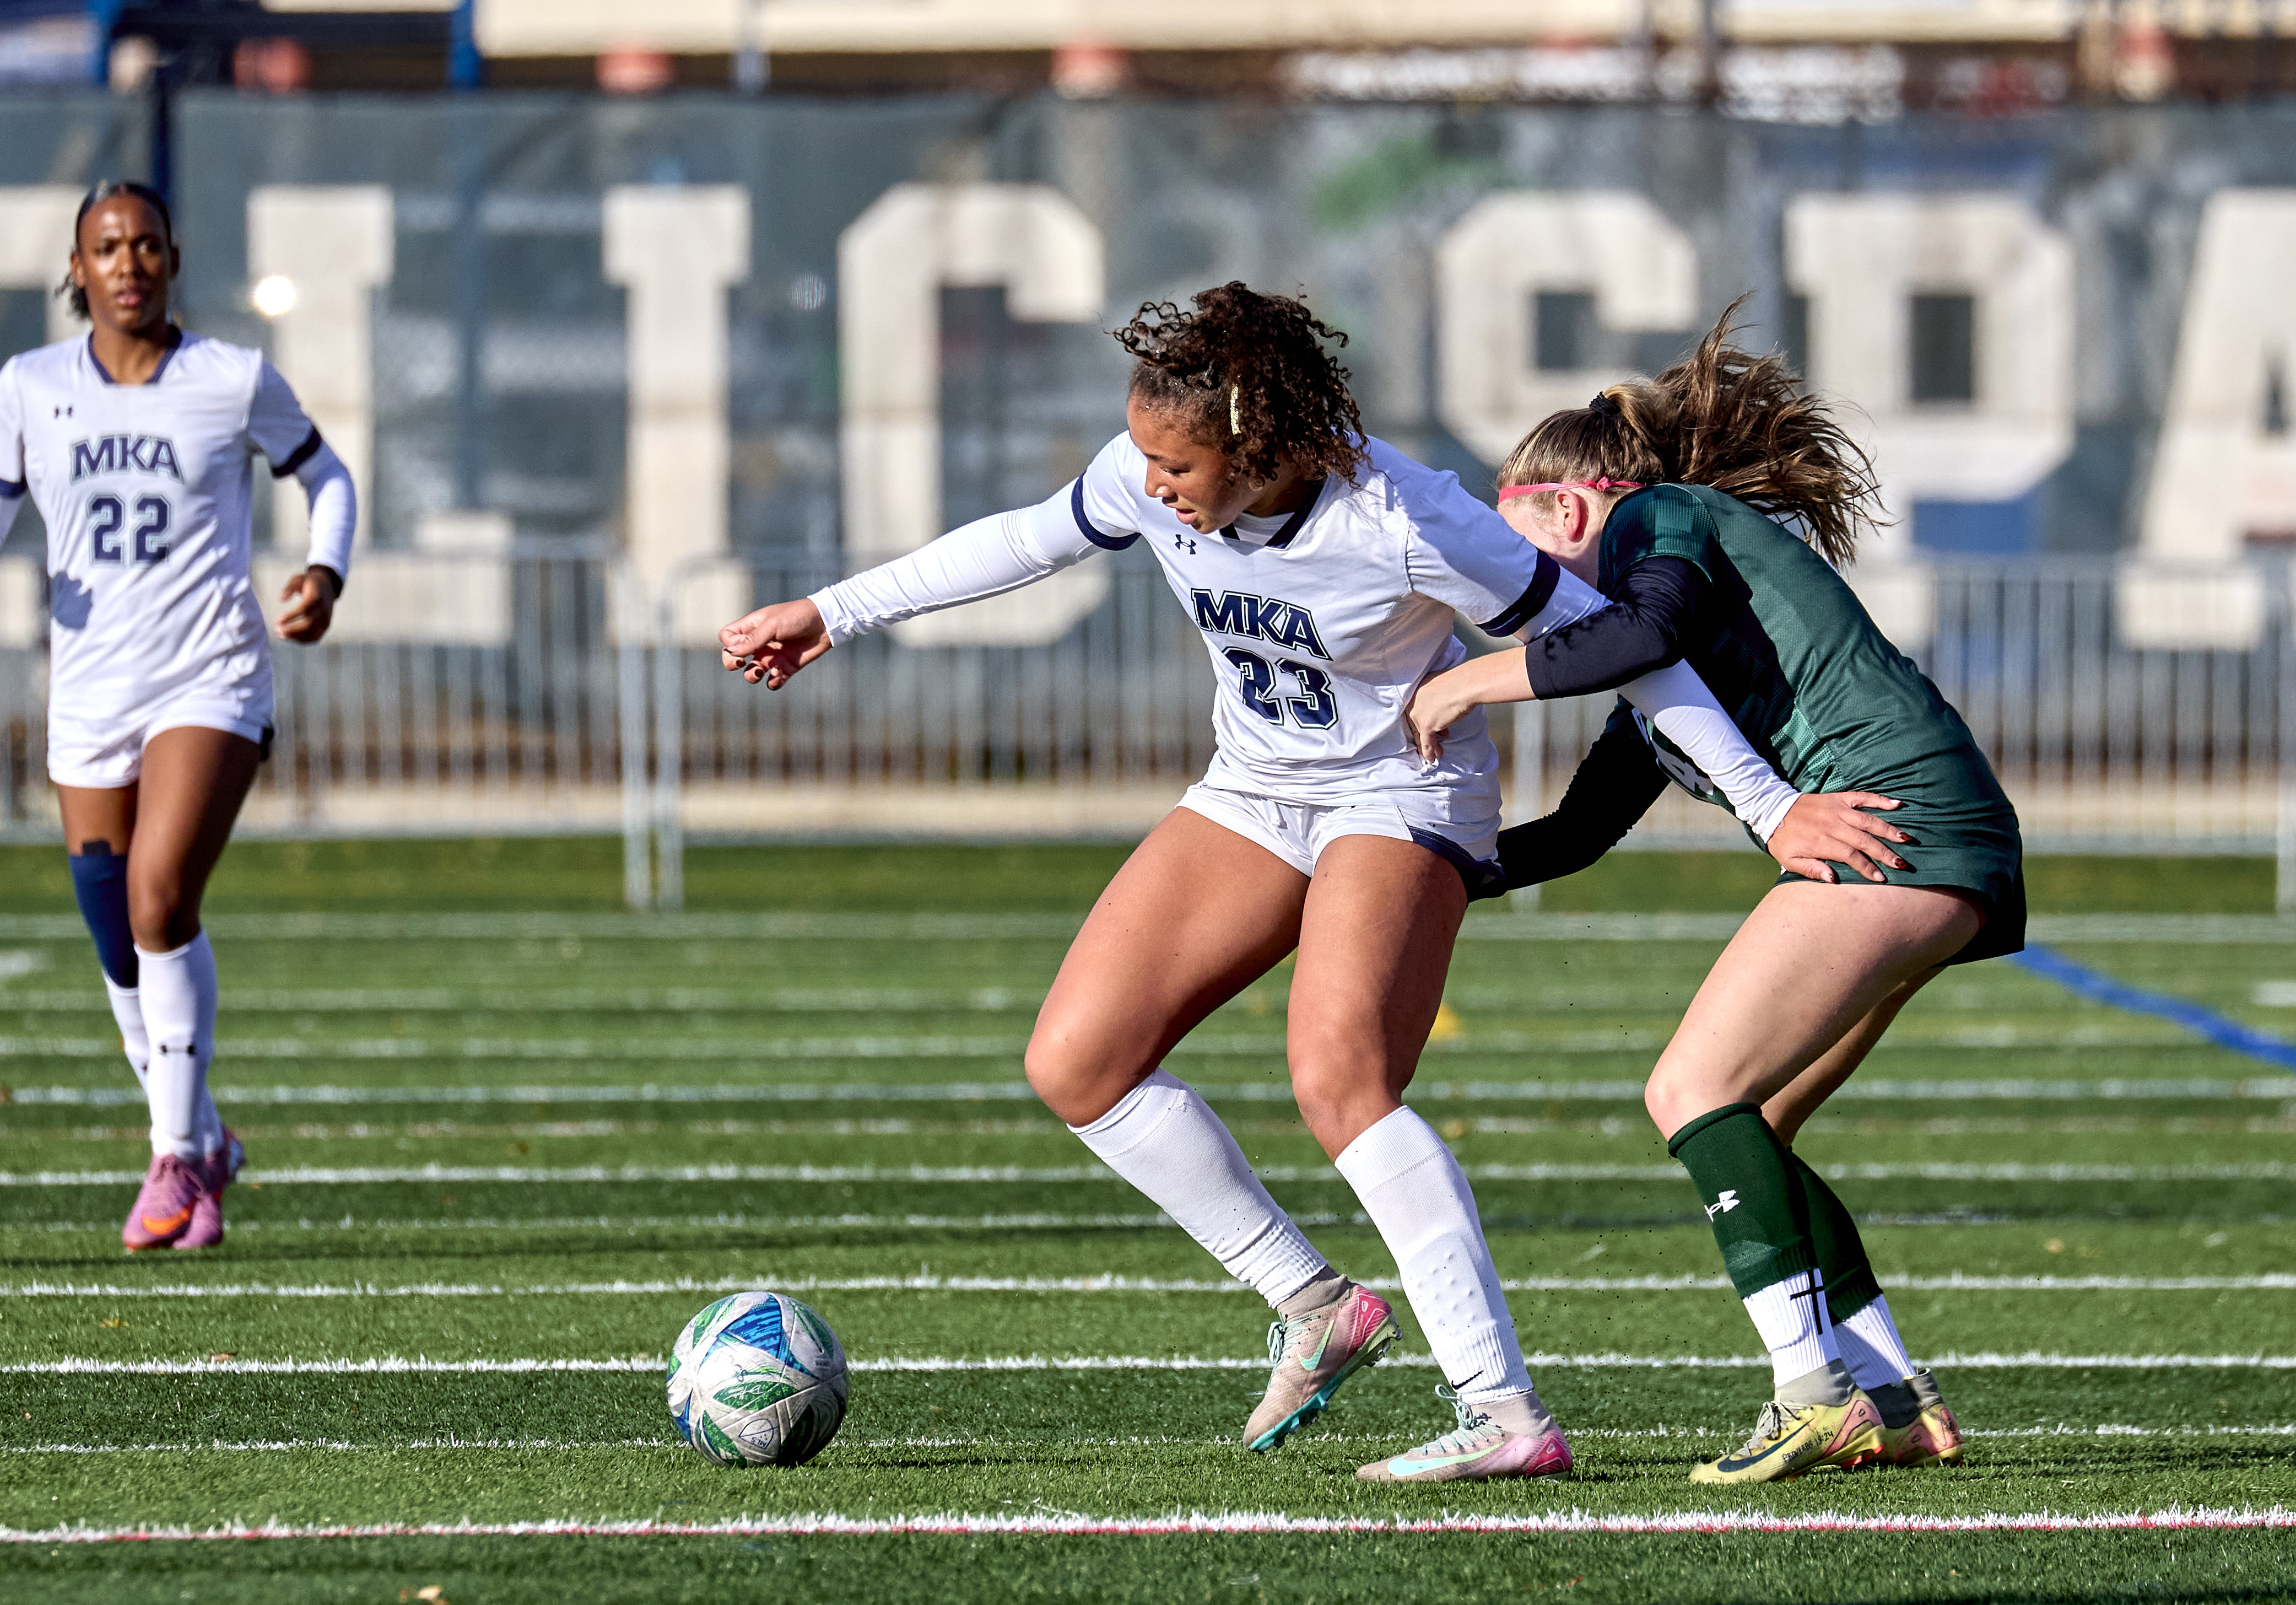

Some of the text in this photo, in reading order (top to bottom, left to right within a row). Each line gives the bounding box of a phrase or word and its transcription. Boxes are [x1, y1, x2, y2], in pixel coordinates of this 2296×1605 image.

[0, 185, 1105, 650] LIC
[69, 434, 185, 484] MKA
[87, 493, 171, 566] 22
[1191, 588, 1333, 661] MKA
[1222, 647, 1338, 730] 23
[751, 1437, 768, 1447] MLS
